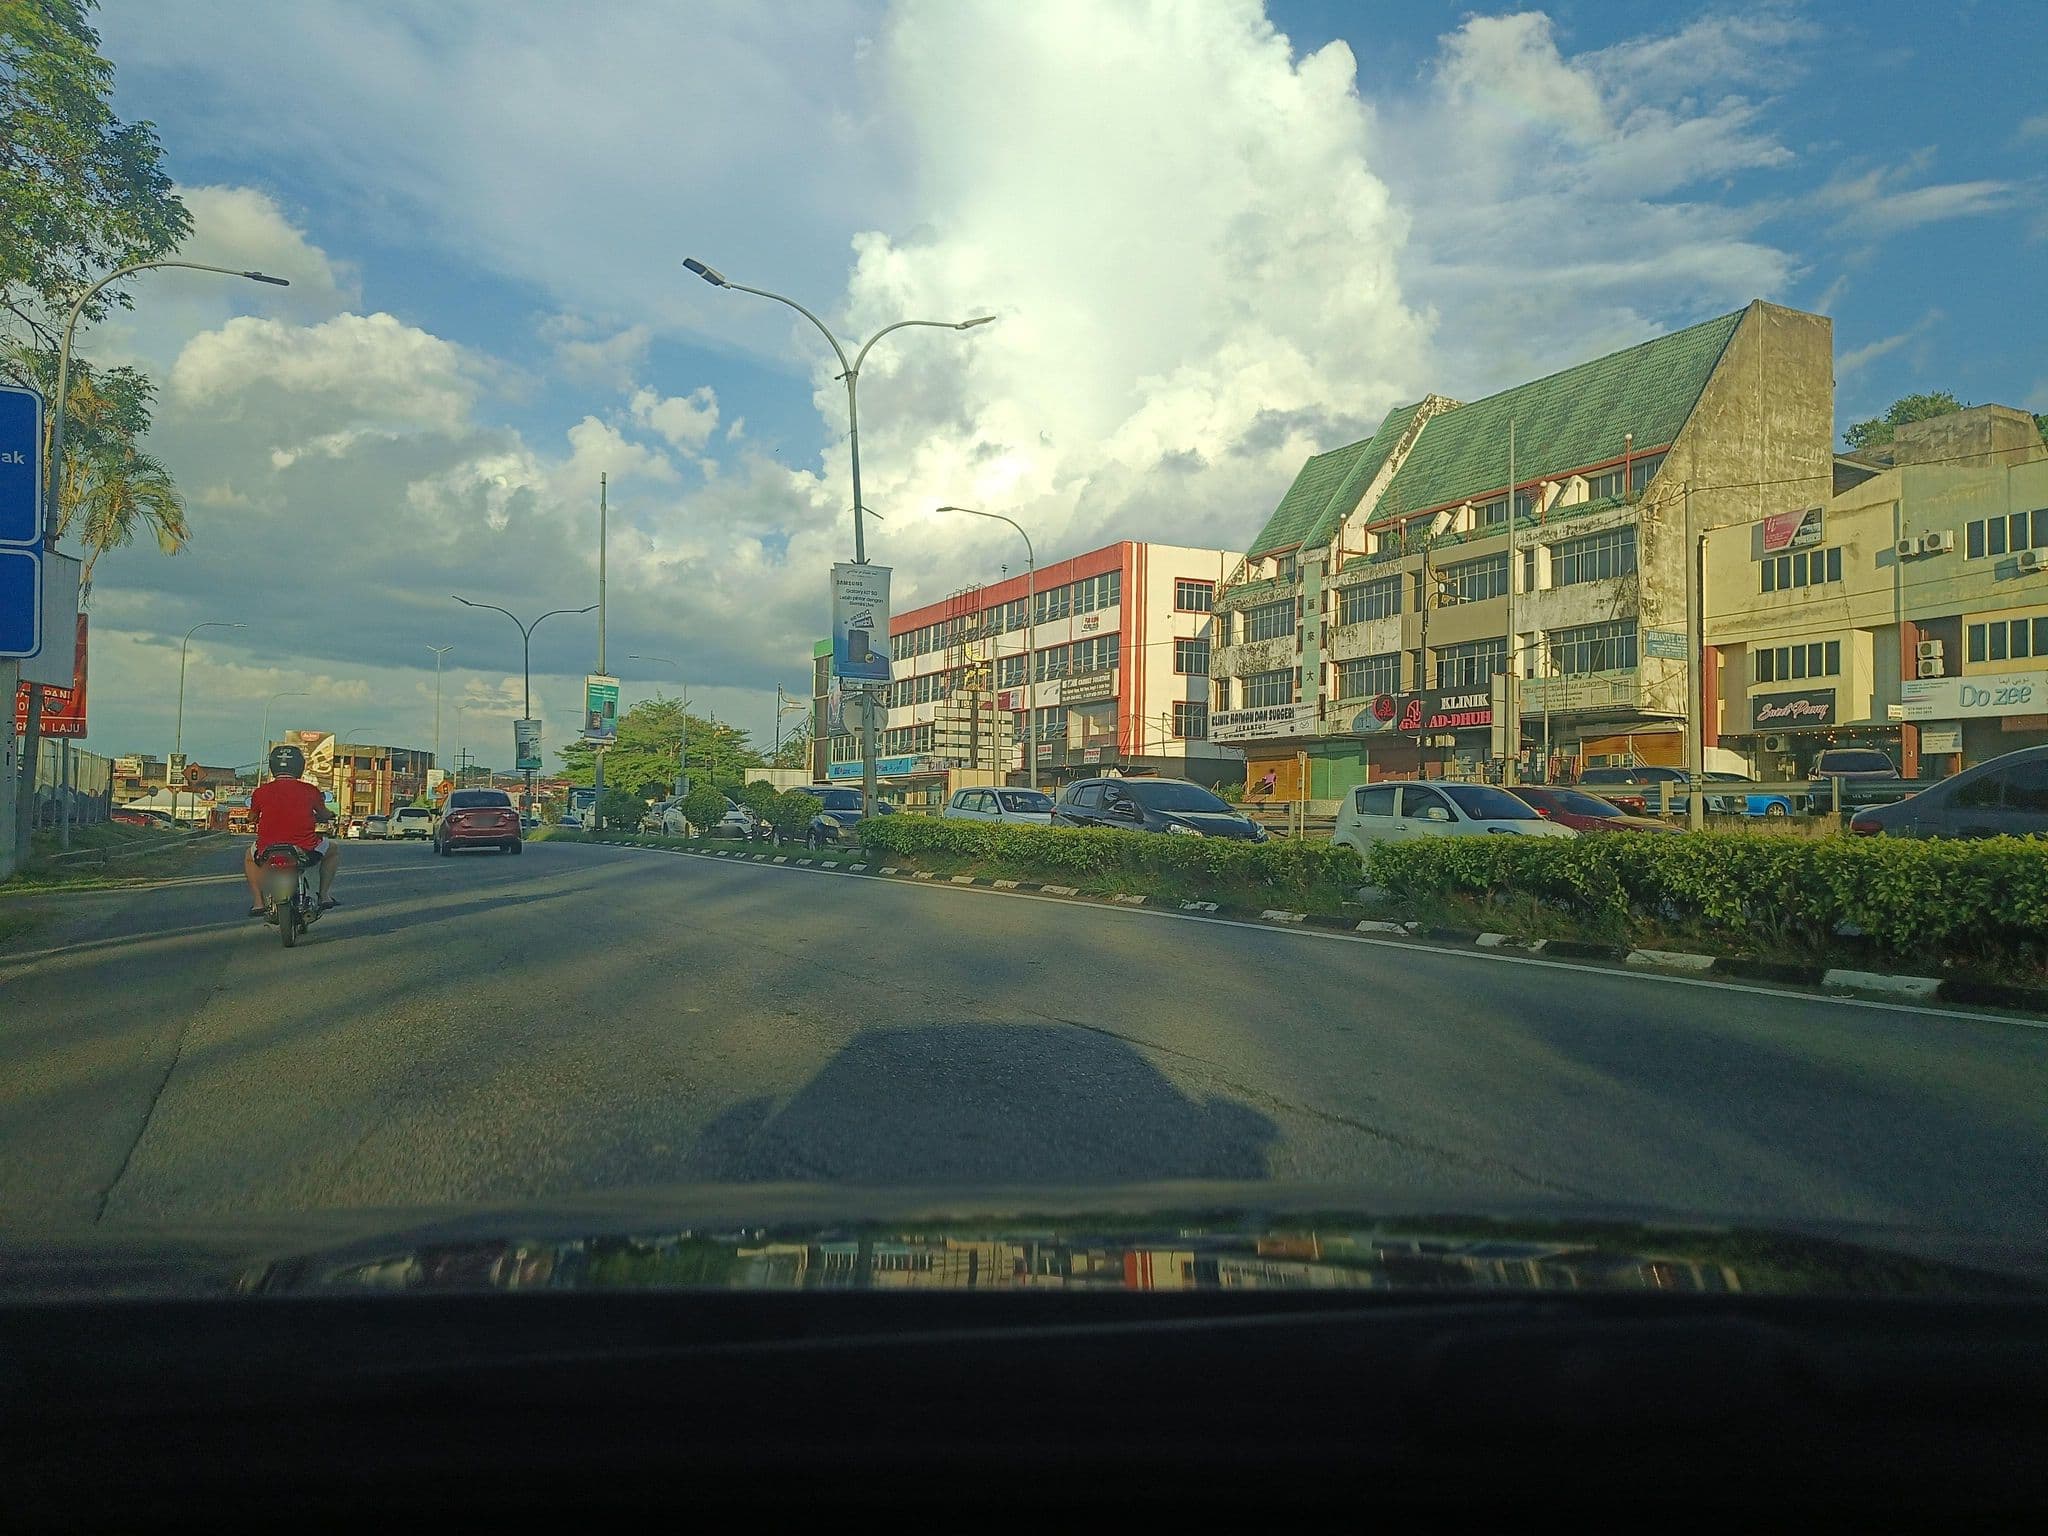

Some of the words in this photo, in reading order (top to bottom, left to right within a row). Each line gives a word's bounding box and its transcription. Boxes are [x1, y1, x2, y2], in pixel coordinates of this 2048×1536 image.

[1441, 693, 1490, 710] KLINIK
[1960, 684, 1991, 708] Do
[1992, 685, 2032, 706] zee
[1212, 714, 1229, 727] KLINIK
[1255, 709, 1268, 723] DAN
[1268, 706, 1295, 721] SURGERI
[1757, 703, 1793, 721] Sweet
[52, 723, 80, 733] LAJU
